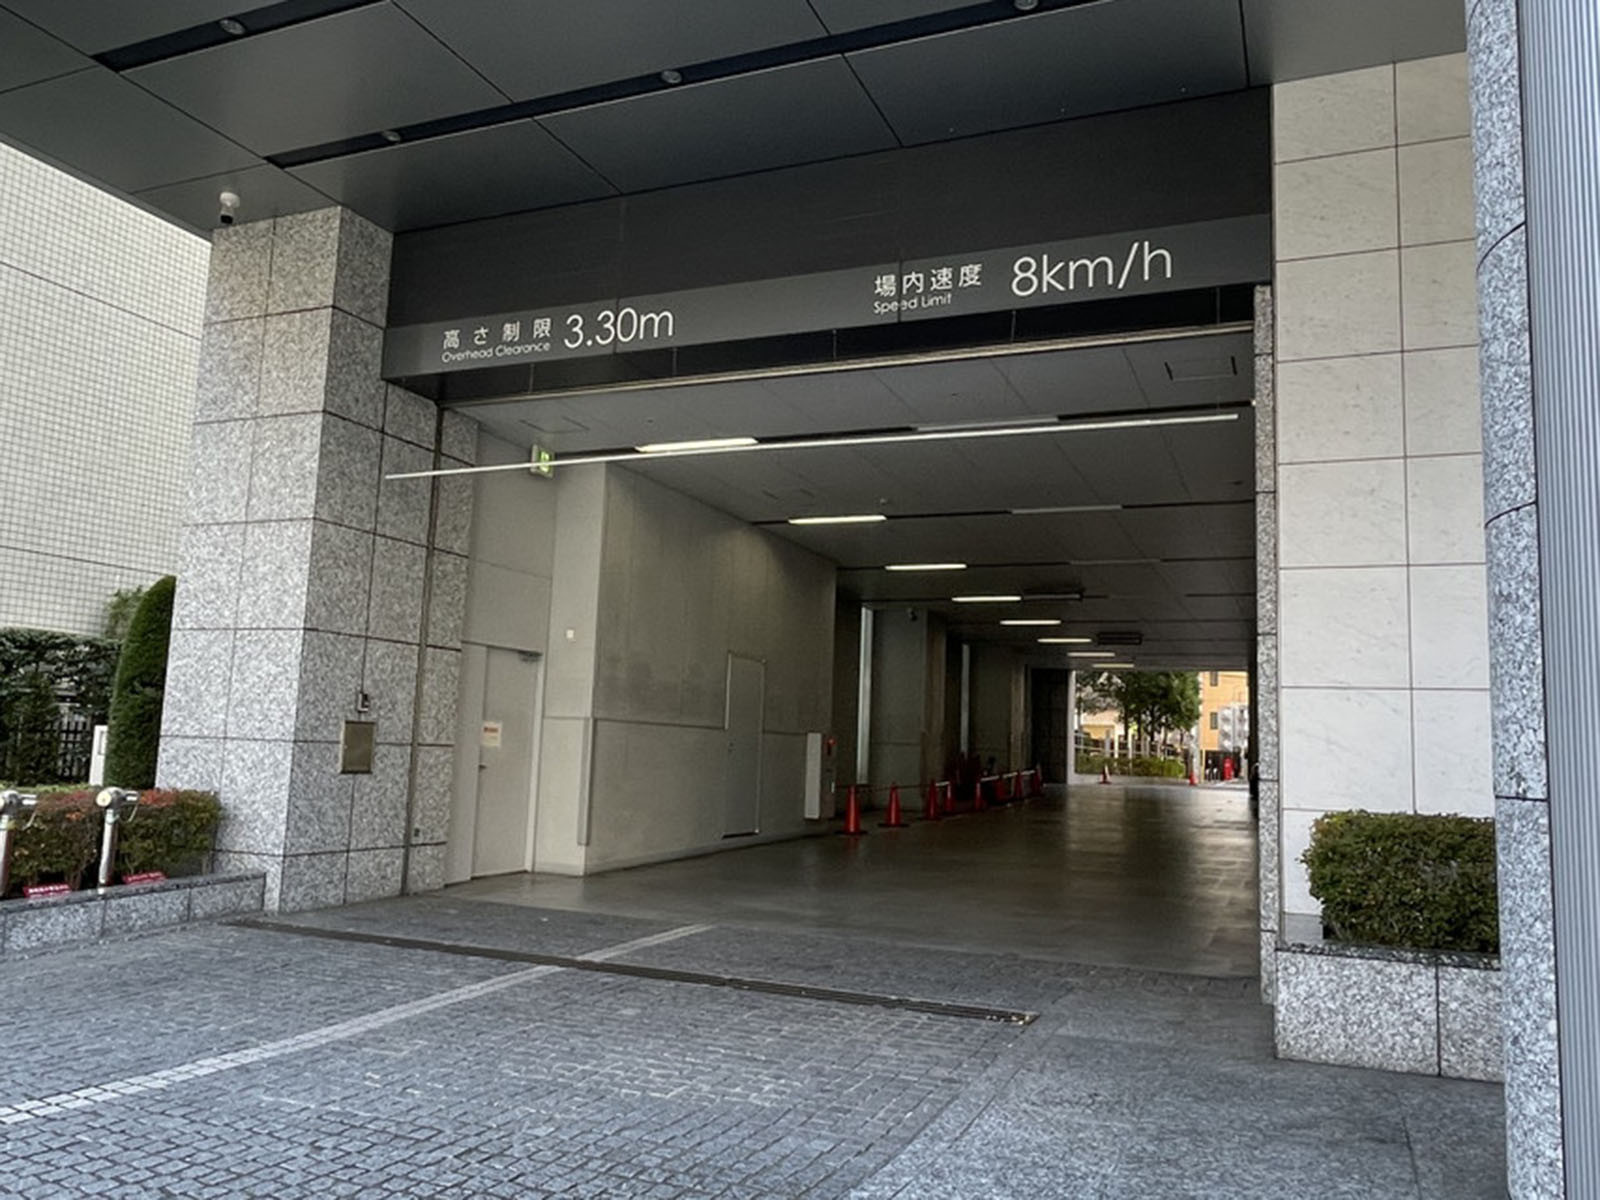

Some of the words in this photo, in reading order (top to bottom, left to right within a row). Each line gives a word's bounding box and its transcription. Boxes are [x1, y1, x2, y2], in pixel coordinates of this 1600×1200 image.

[874, 263, 983, 298] 場内速度
[1011, 240, 1172, 297] 8km/h
[873, 296, 919, 315] Speed
[921, 292, 952, 308] Limit
[443, 317, 552, 350] 高さ制限
[563, 306, 674, 349] 3.30m
[441, 347, 493, 363] Overhead
[495, 341, 552, 357] Clearance
